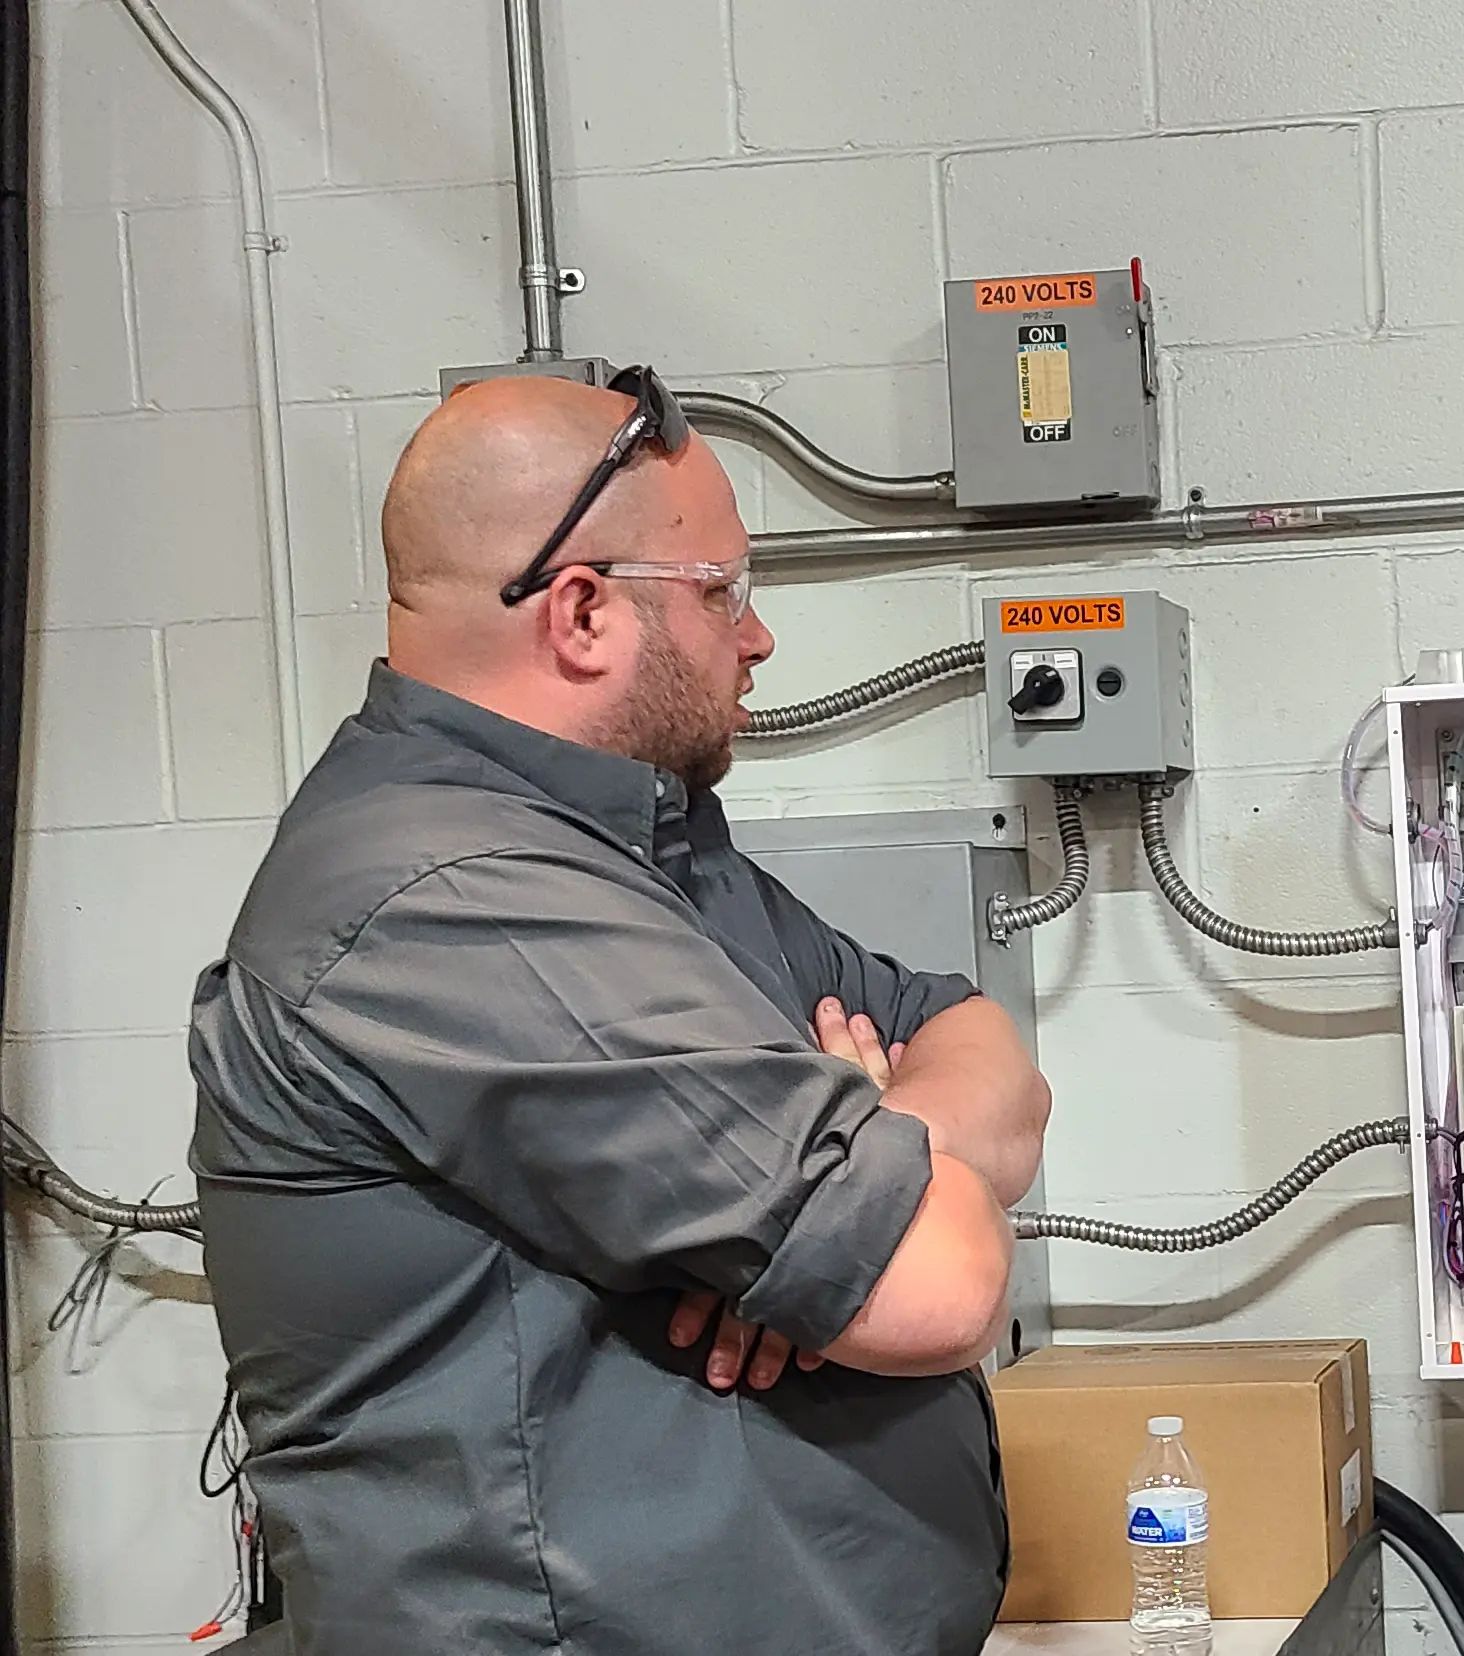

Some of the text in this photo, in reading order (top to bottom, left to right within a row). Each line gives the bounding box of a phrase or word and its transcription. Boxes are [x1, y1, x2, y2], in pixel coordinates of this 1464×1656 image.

[981, 280, 1093, 306] 240 VOLTS
[1028, 326, 1056, 343] ON
[1029, 425, 1065, 441] OFF
[1007, 603, 1121, 626] 240 VOLTS
[1131, 1526, 1163, 1537] WATER
